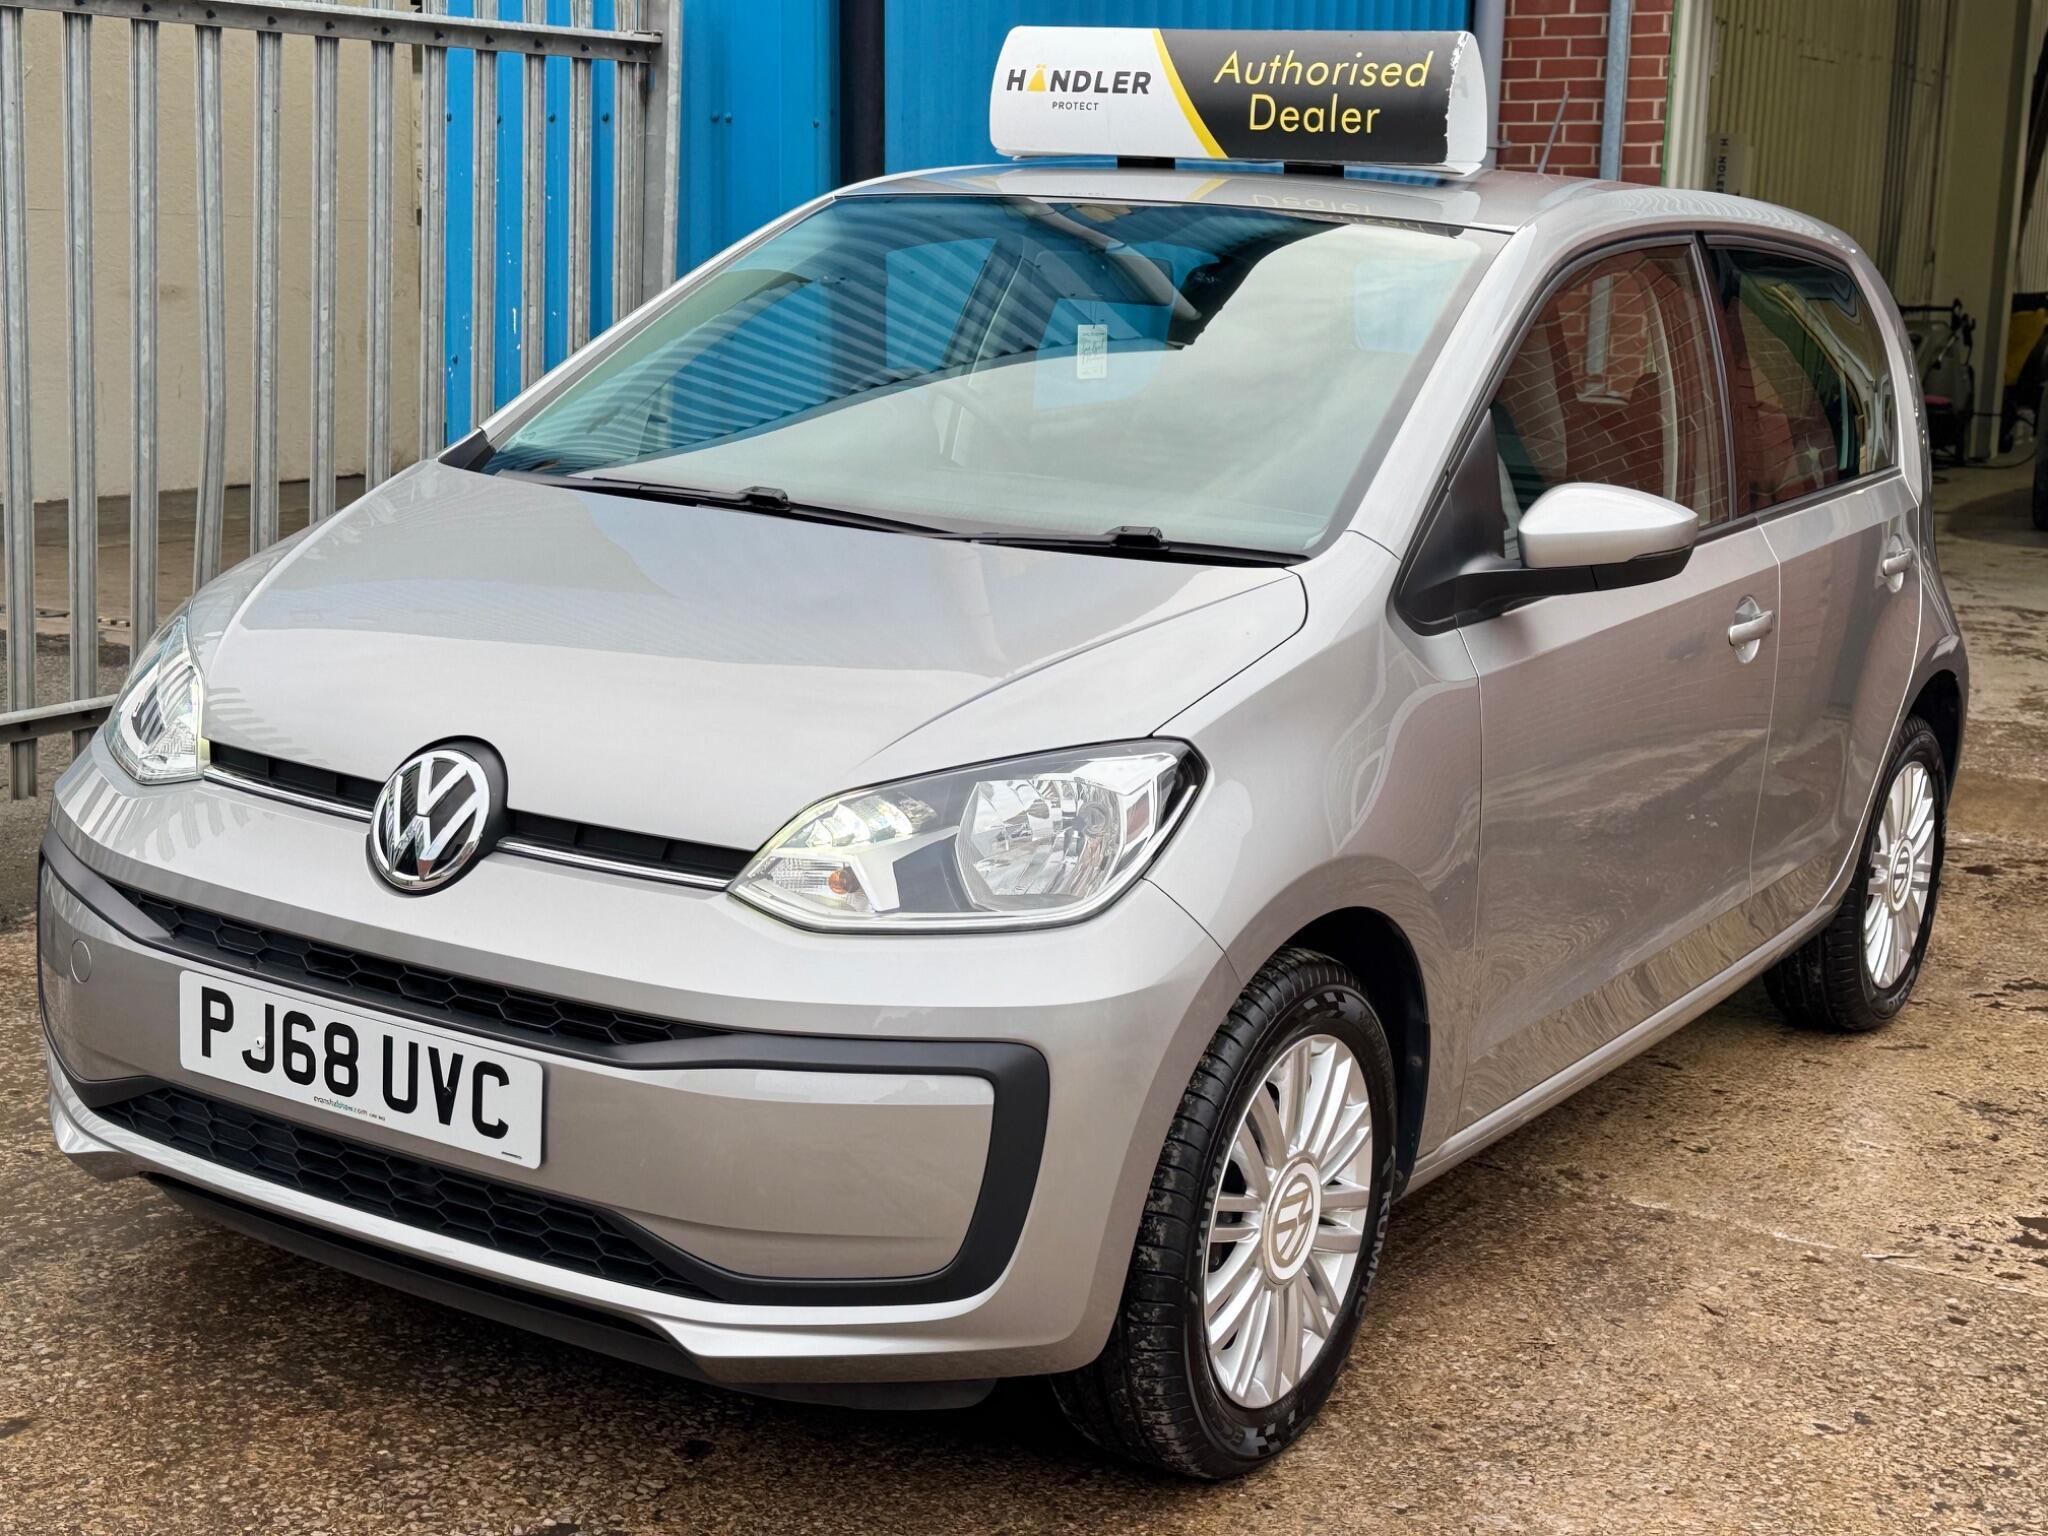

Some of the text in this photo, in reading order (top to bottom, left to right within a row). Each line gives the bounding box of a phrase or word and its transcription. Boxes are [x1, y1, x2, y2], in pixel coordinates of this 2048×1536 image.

[1213, 49, 1434, 88] Authorised
[1052, 101, 1099, 111] PROTECT
[1249, 93, 1381, 134] Dealer
[201, 986, 510, 1140] PJ68 UVC
